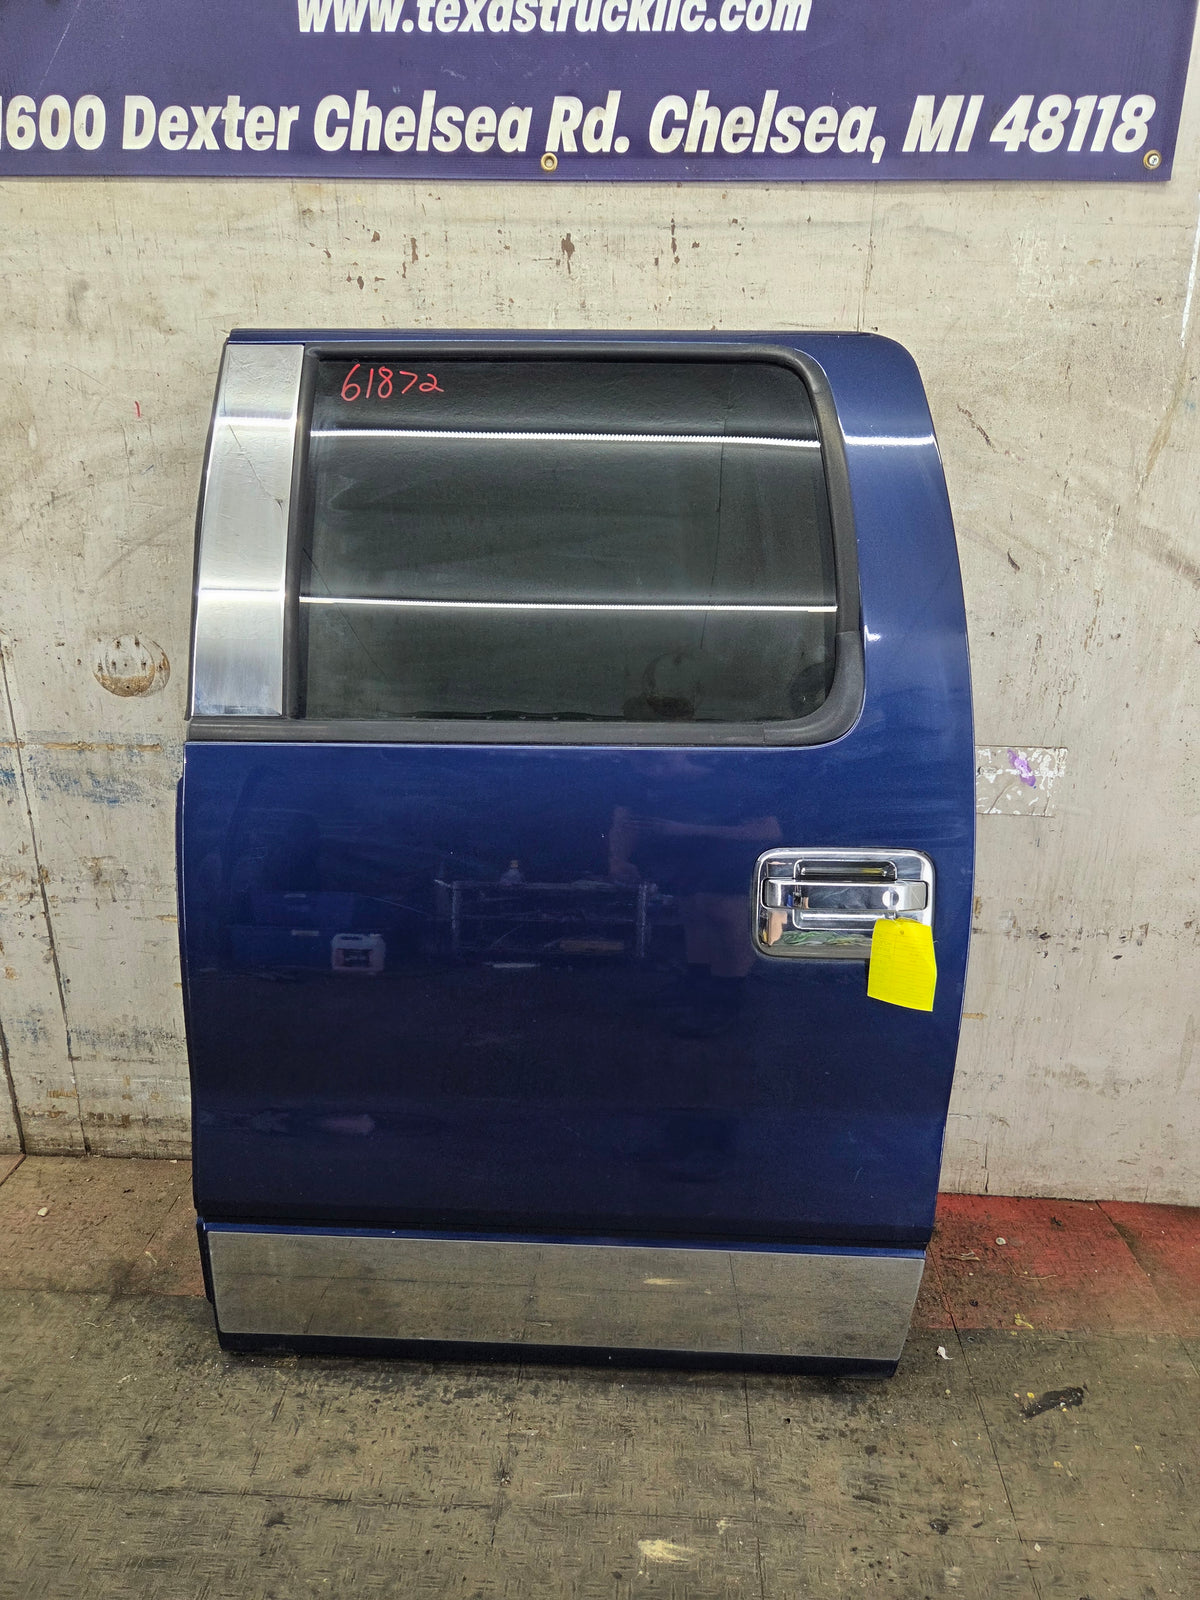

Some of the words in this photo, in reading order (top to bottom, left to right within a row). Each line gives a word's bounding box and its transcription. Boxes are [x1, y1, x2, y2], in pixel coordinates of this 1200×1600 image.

[297, 0, 812, 34] www.texastruckllc.com
[0, 94, 107, 151] 600
[121, 94, 300, 152] Dexter
[313, 89, 534, 153] Chelsea
[544, 89, 630, 154] Rd.
[648, 89, 886, 164] Chelsea,
[901, 94, 985, 153] MI
[988, 93, 1157, 154] 48118
[340, 363, 445, 402] 61872
